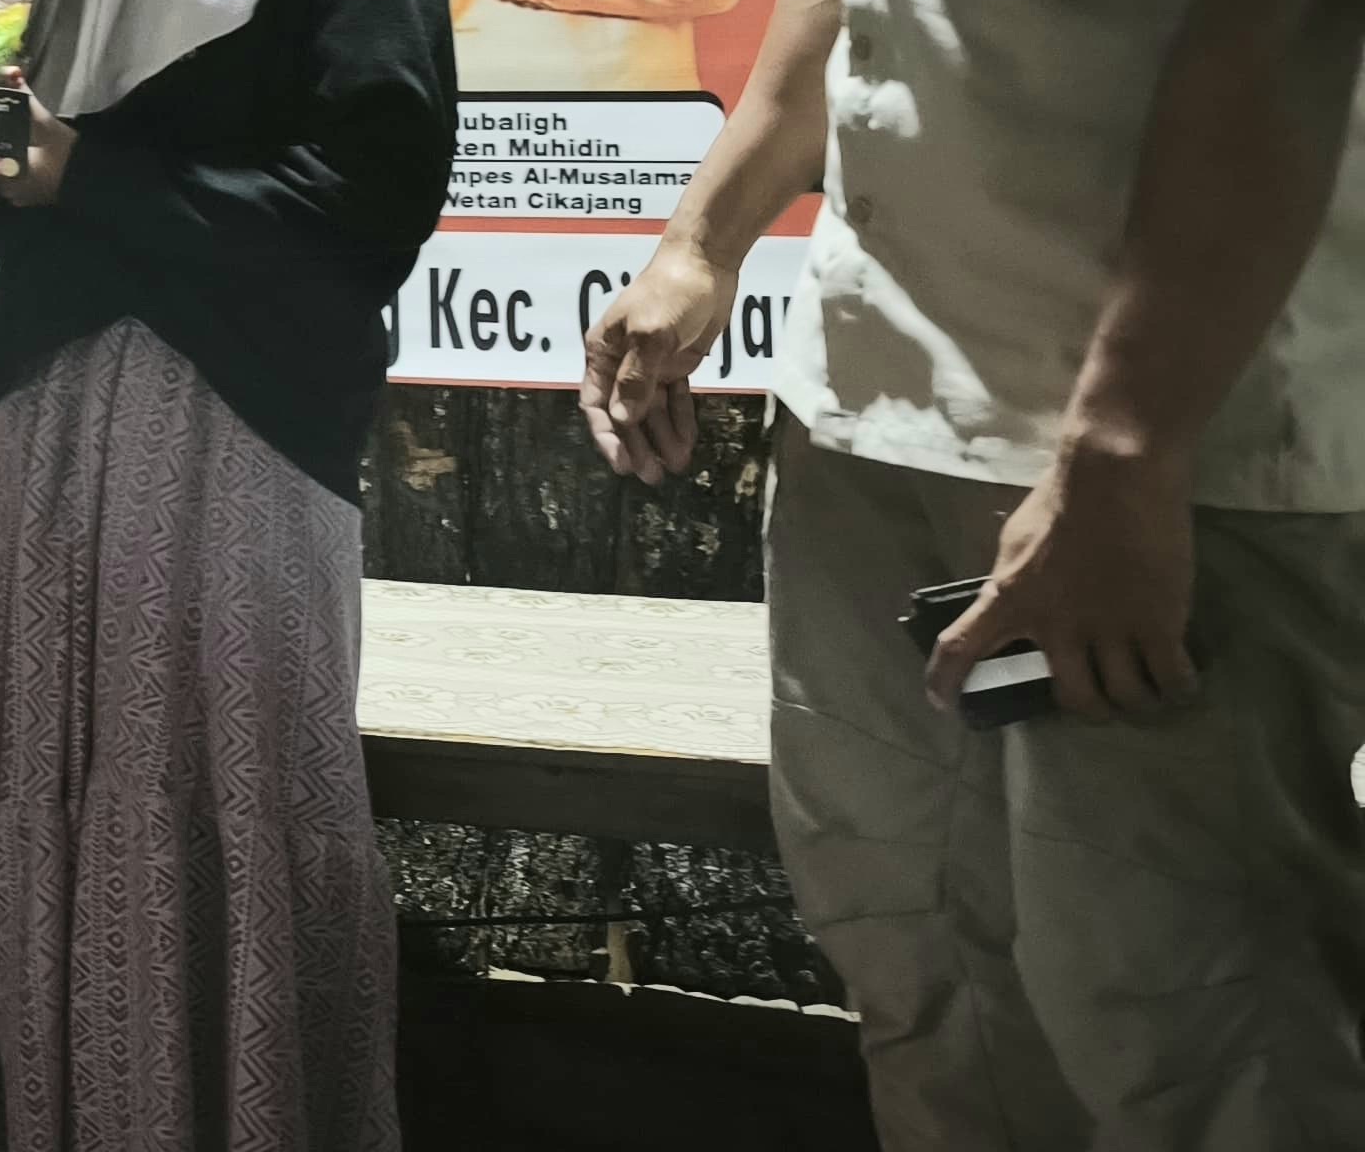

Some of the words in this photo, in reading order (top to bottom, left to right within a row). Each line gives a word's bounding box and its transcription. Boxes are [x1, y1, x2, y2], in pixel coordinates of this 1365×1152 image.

[455, 112, 568, 135] ubaligh
[509, 138, 621, 158] Muhidin
[523, 167, 693, 187] Al-Musalama
[527, 192, 643, 215] Cikajang
[428, 267, 552, 353] Kec.
